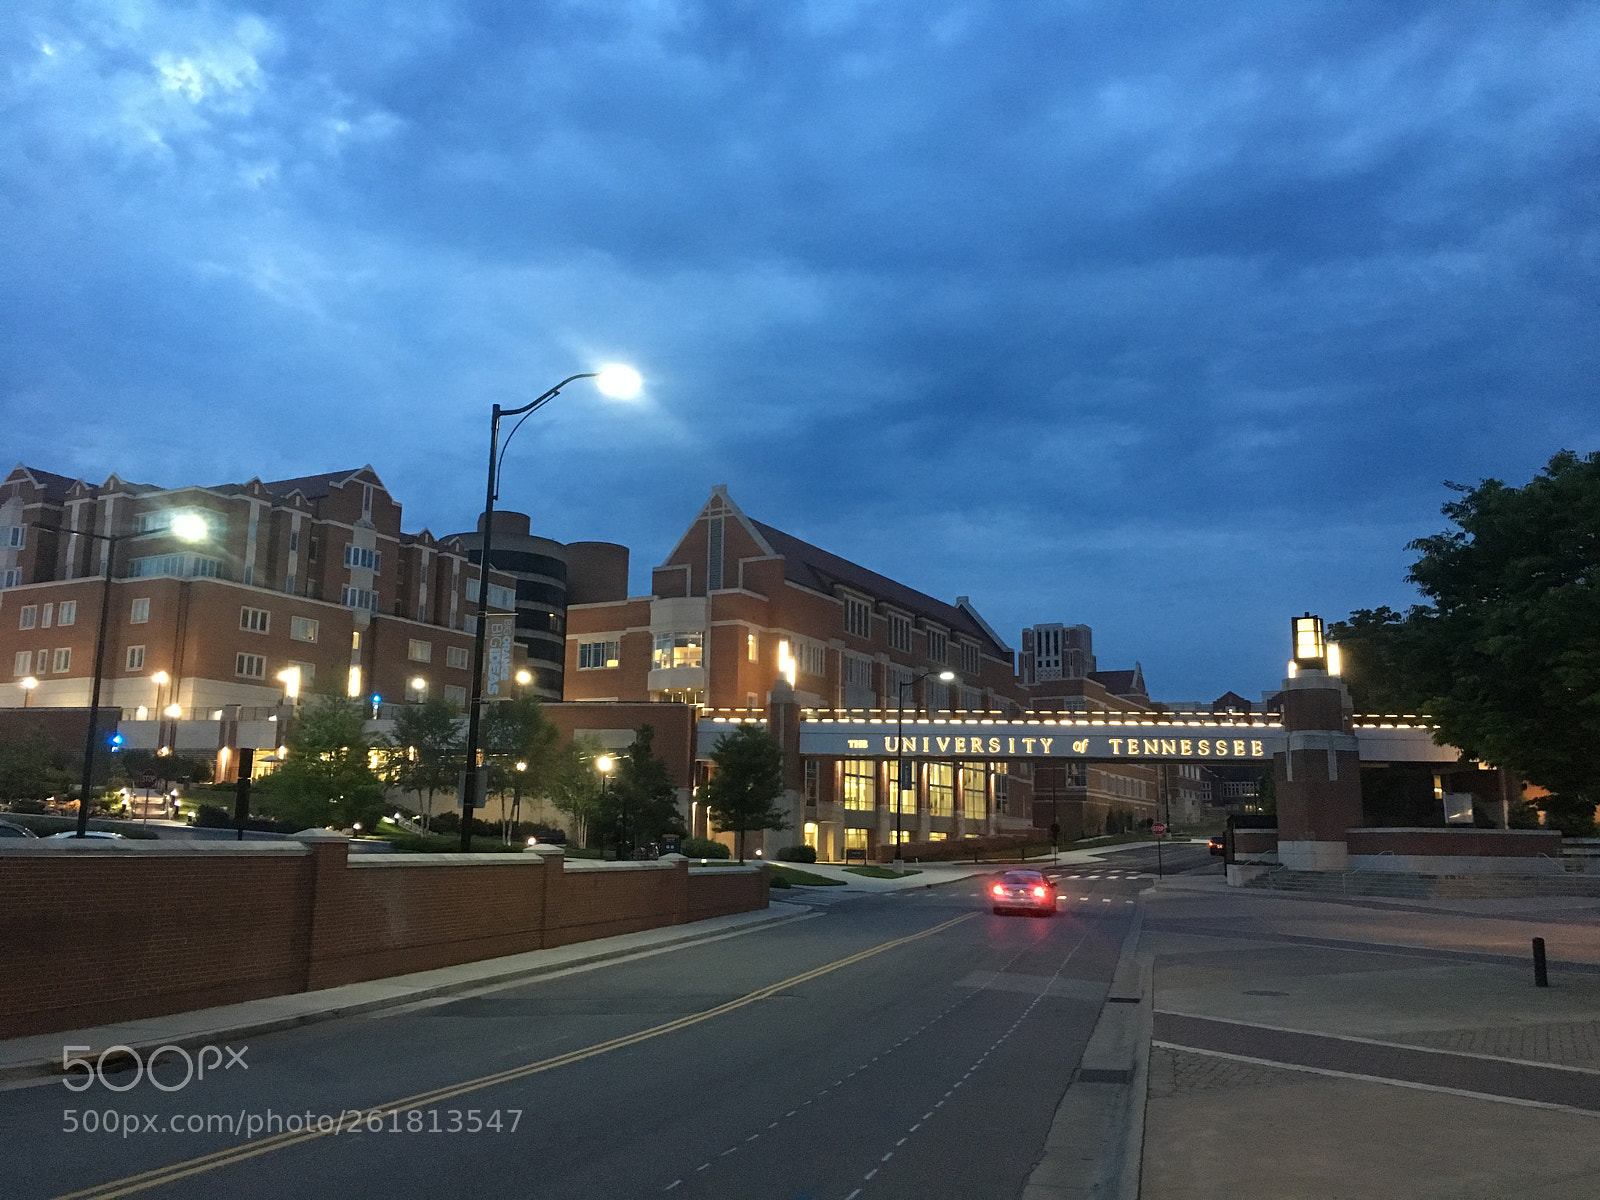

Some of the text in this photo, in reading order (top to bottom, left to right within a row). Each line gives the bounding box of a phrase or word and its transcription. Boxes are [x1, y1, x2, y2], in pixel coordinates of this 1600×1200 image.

[503, 618, 512, 636] BIG
[487, 623, 503, 695] BIG IDEAS
[847, 736, 1264, 757] THE UNIVERSITY of TENNESSEE
